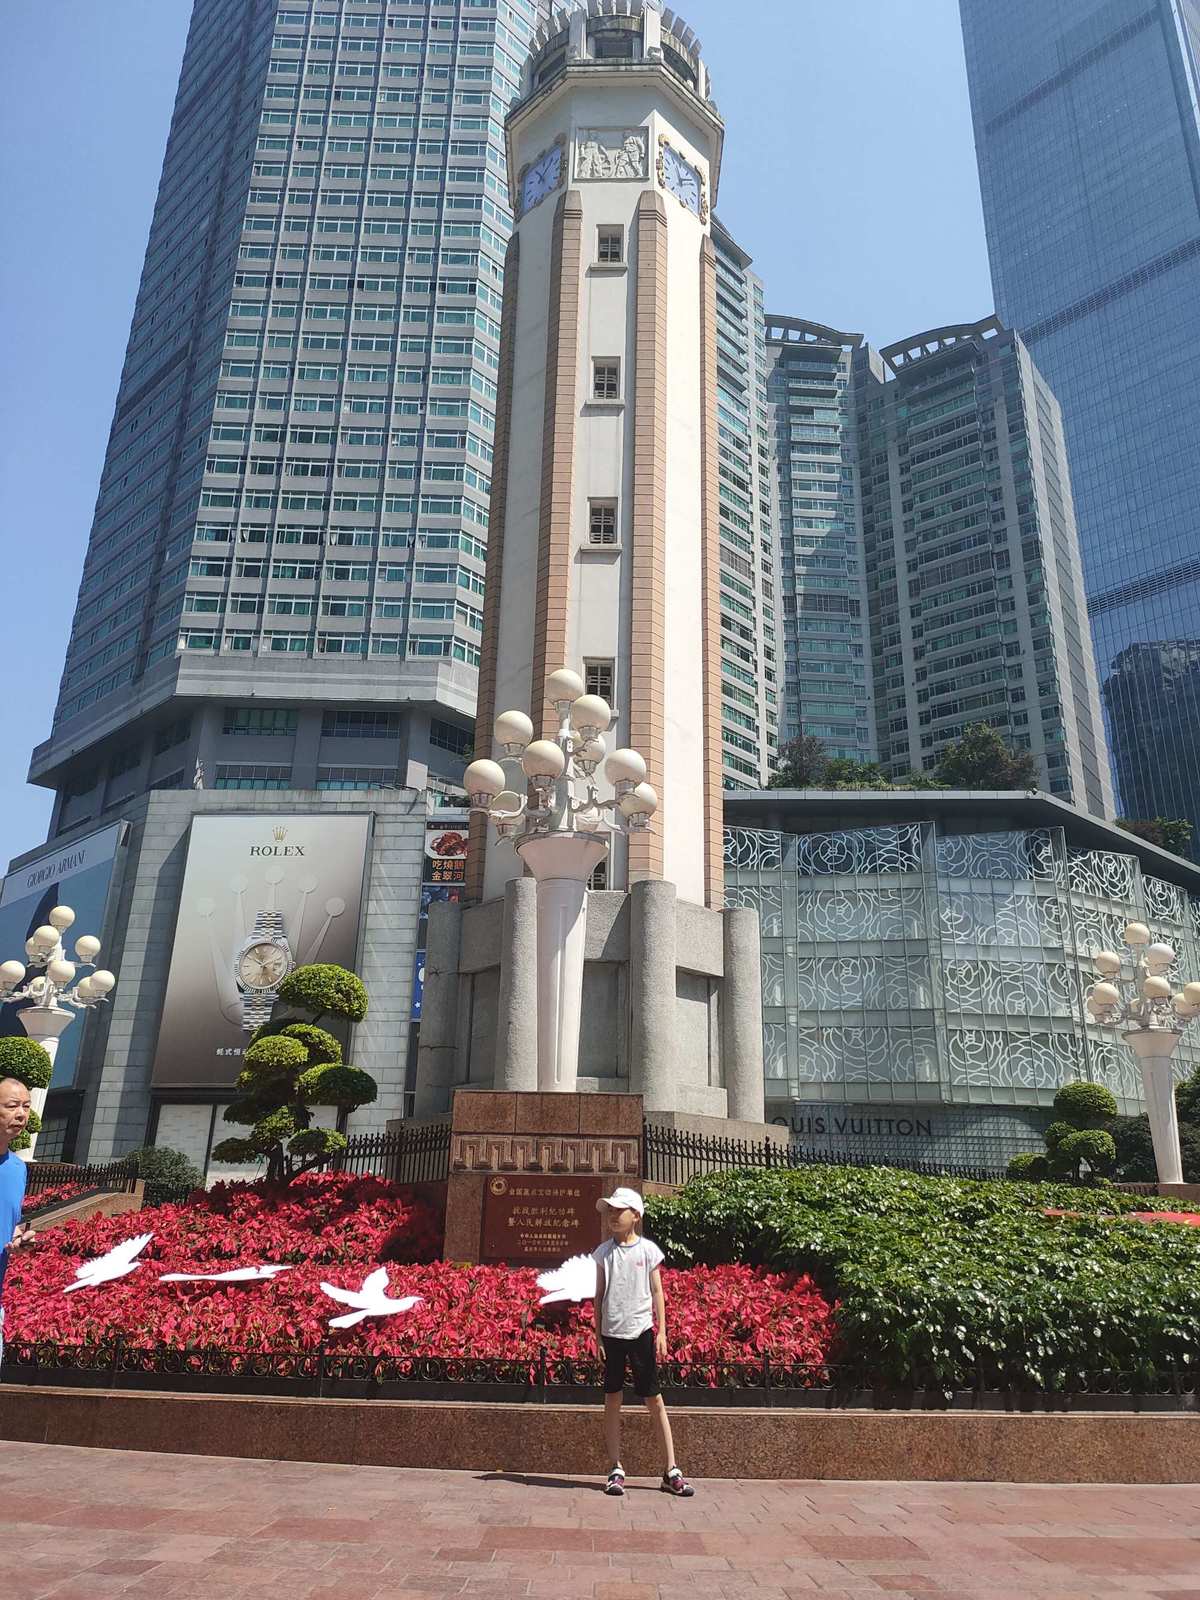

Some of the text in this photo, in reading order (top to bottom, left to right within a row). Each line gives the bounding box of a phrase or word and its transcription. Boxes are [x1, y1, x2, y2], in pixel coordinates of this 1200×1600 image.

[250, 846, 305, 856] ROLEX
[771, 1116, 932, 1136] OUIS VUITTON
